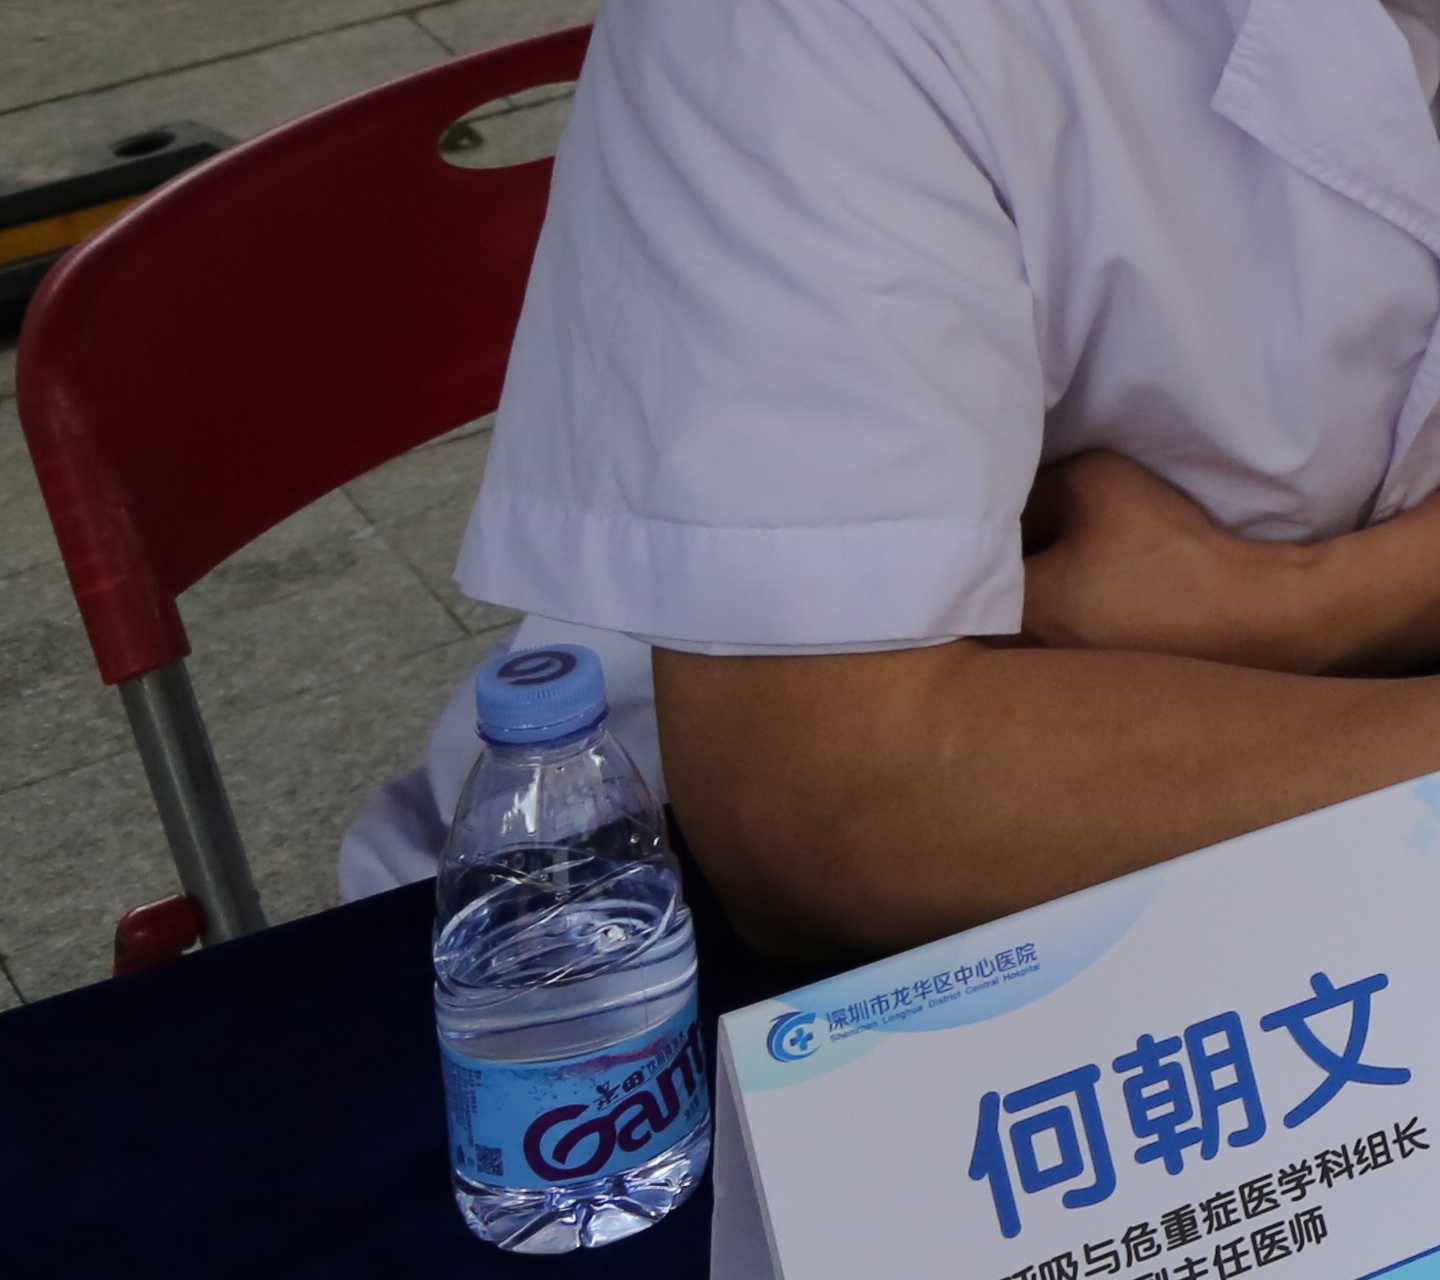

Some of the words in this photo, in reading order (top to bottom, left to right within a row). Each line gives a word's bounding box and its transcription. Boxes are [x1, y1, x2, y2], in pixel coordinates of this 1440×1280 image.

[825, 942, 1039, 1032] 深圳市龙华区中心医院
[829, 1021, 879, 1043] Shenzhen
[881, 1005, 924, 1025] Longhua
[928, 991, 962, 1009] District
[965, 978, 1000, 995] Central
[1003, 963, 1041, 982] Hospital
[966, 970, 1412, 1239] 何朝文
